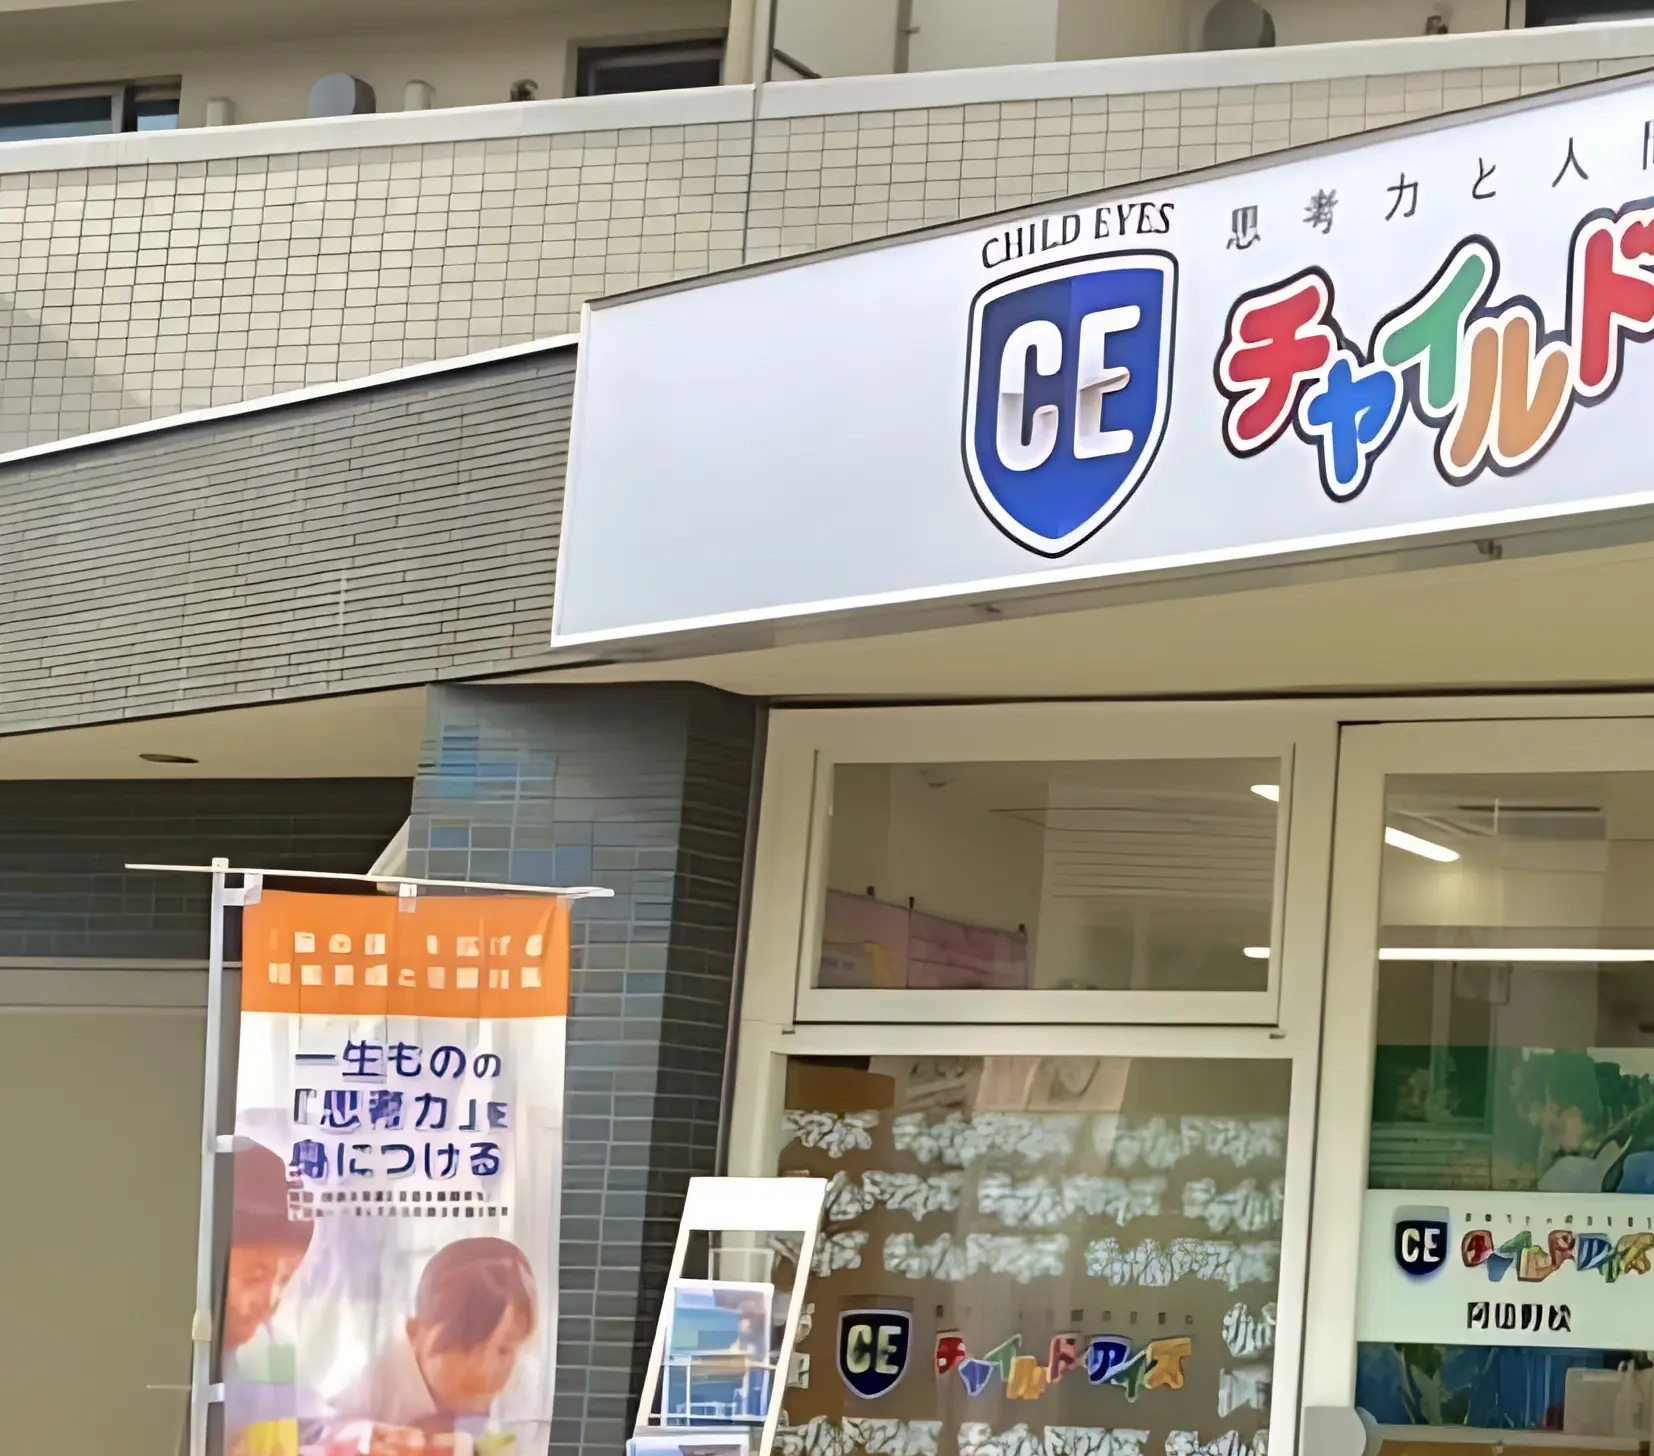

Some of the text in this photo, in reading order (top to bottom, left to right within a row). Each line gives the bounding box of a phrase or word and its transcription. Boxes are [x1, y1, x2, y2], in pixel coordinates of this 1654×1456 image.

[981, 202, 1175, 268] CHILD EYES
[994, 300, 1142, 471] CE
[295, 1040, 501, 1080] 一生ものの
[1401, 1228, 1441, 1263] CE
[846, 1324, 902, 1375] CE
